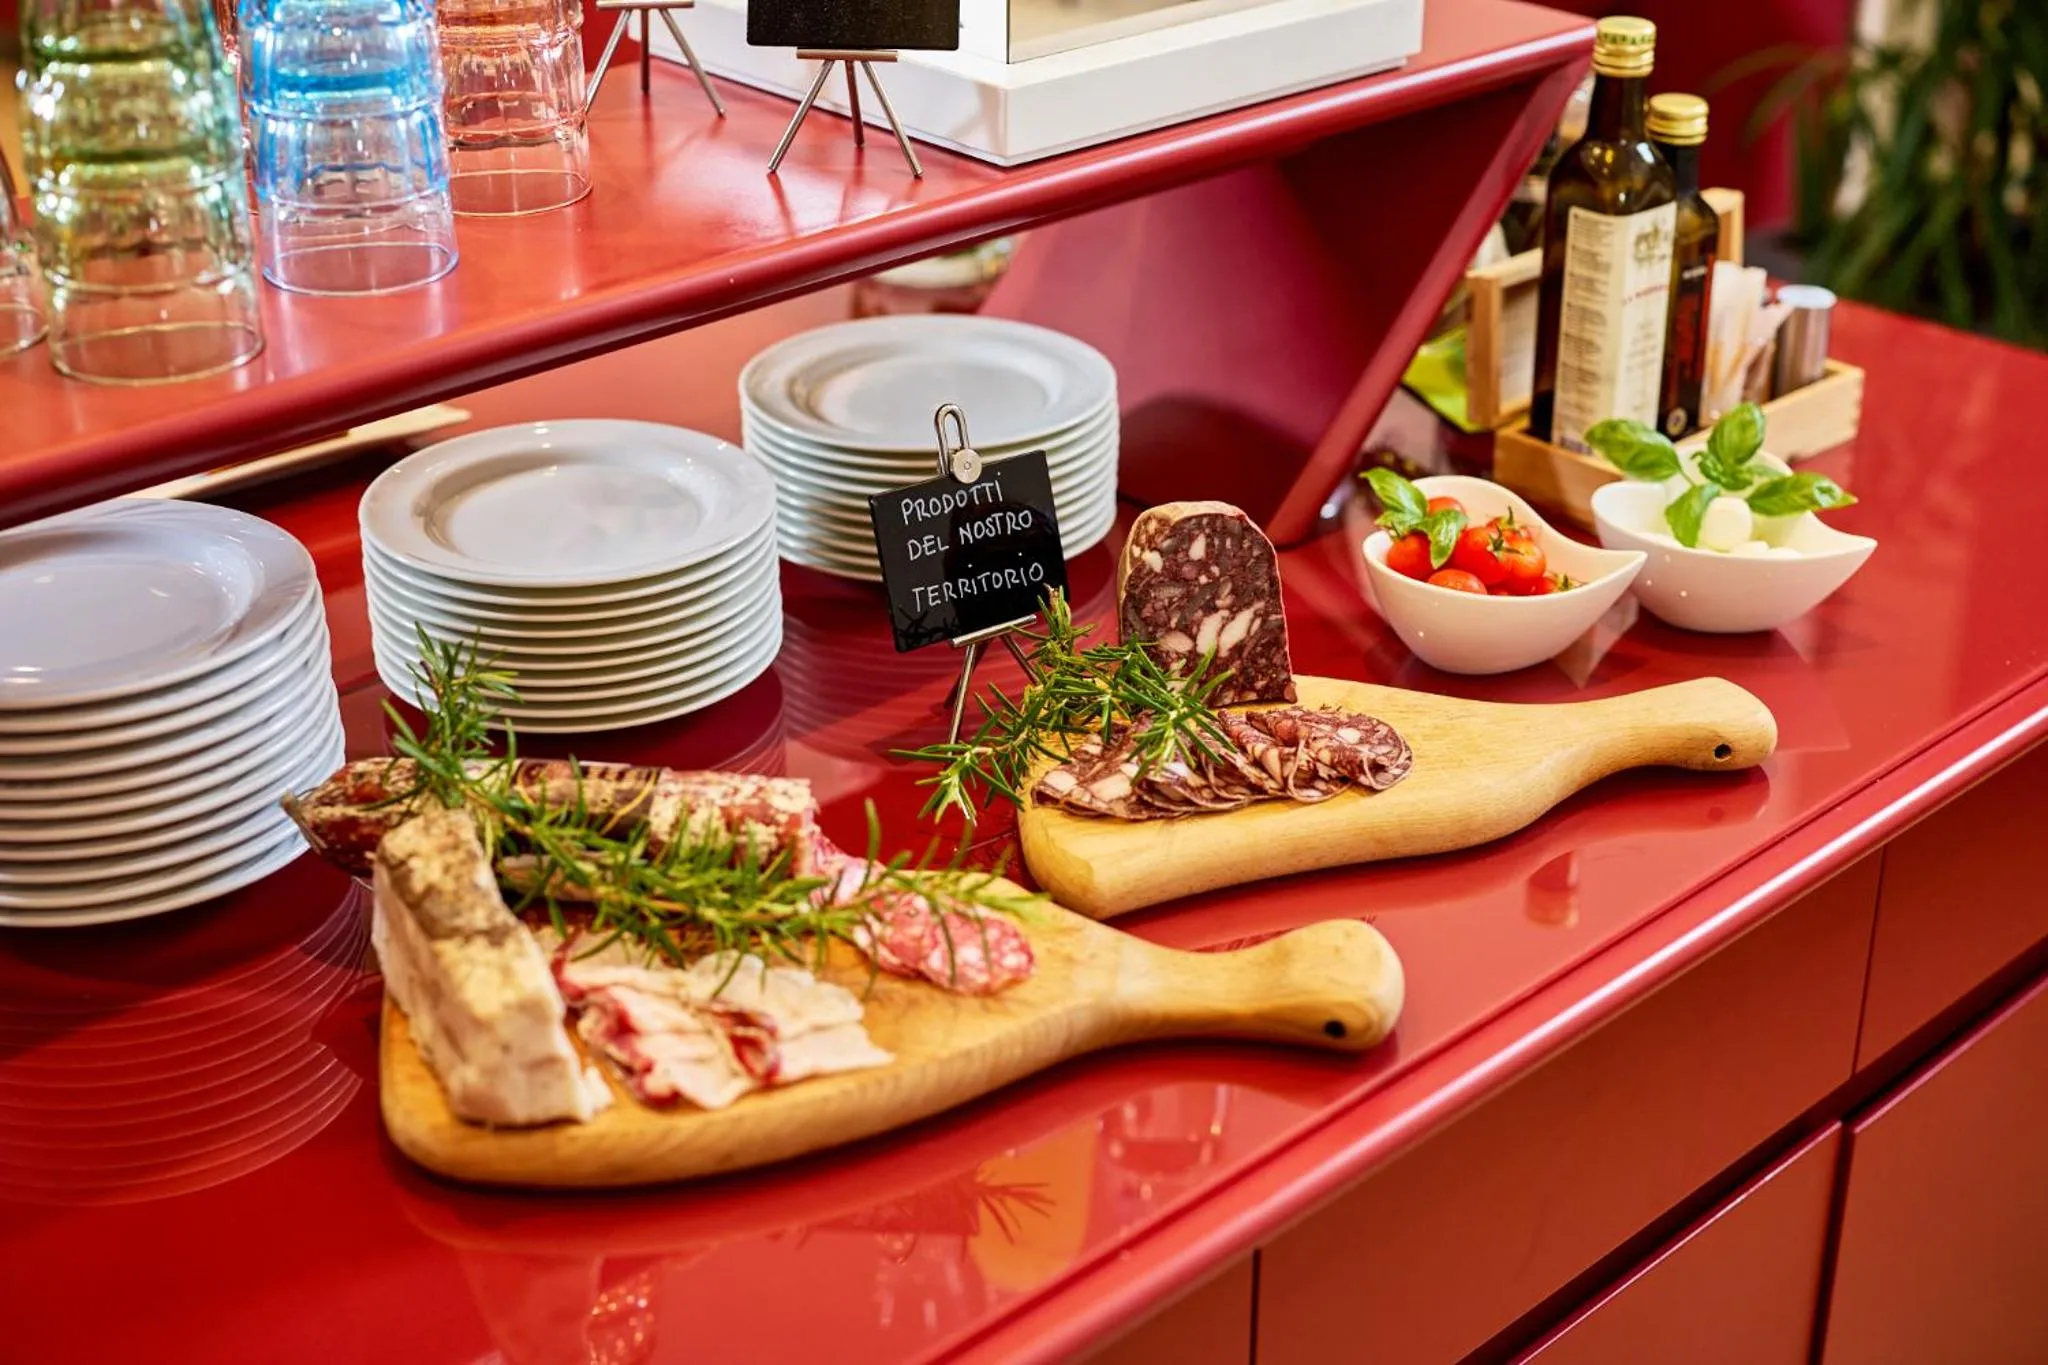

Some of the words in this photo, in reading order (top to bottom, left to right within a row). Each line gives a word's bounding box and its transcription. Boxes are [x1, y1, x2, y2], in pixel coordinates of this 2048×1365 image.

[901, 473, 1003, 525] PRODOTTI
[907, 535, 949, 561] DEL
[959, 510, 1033, 545] NOSTRO
[912, 555, 1044, 612] TERRITORIO
